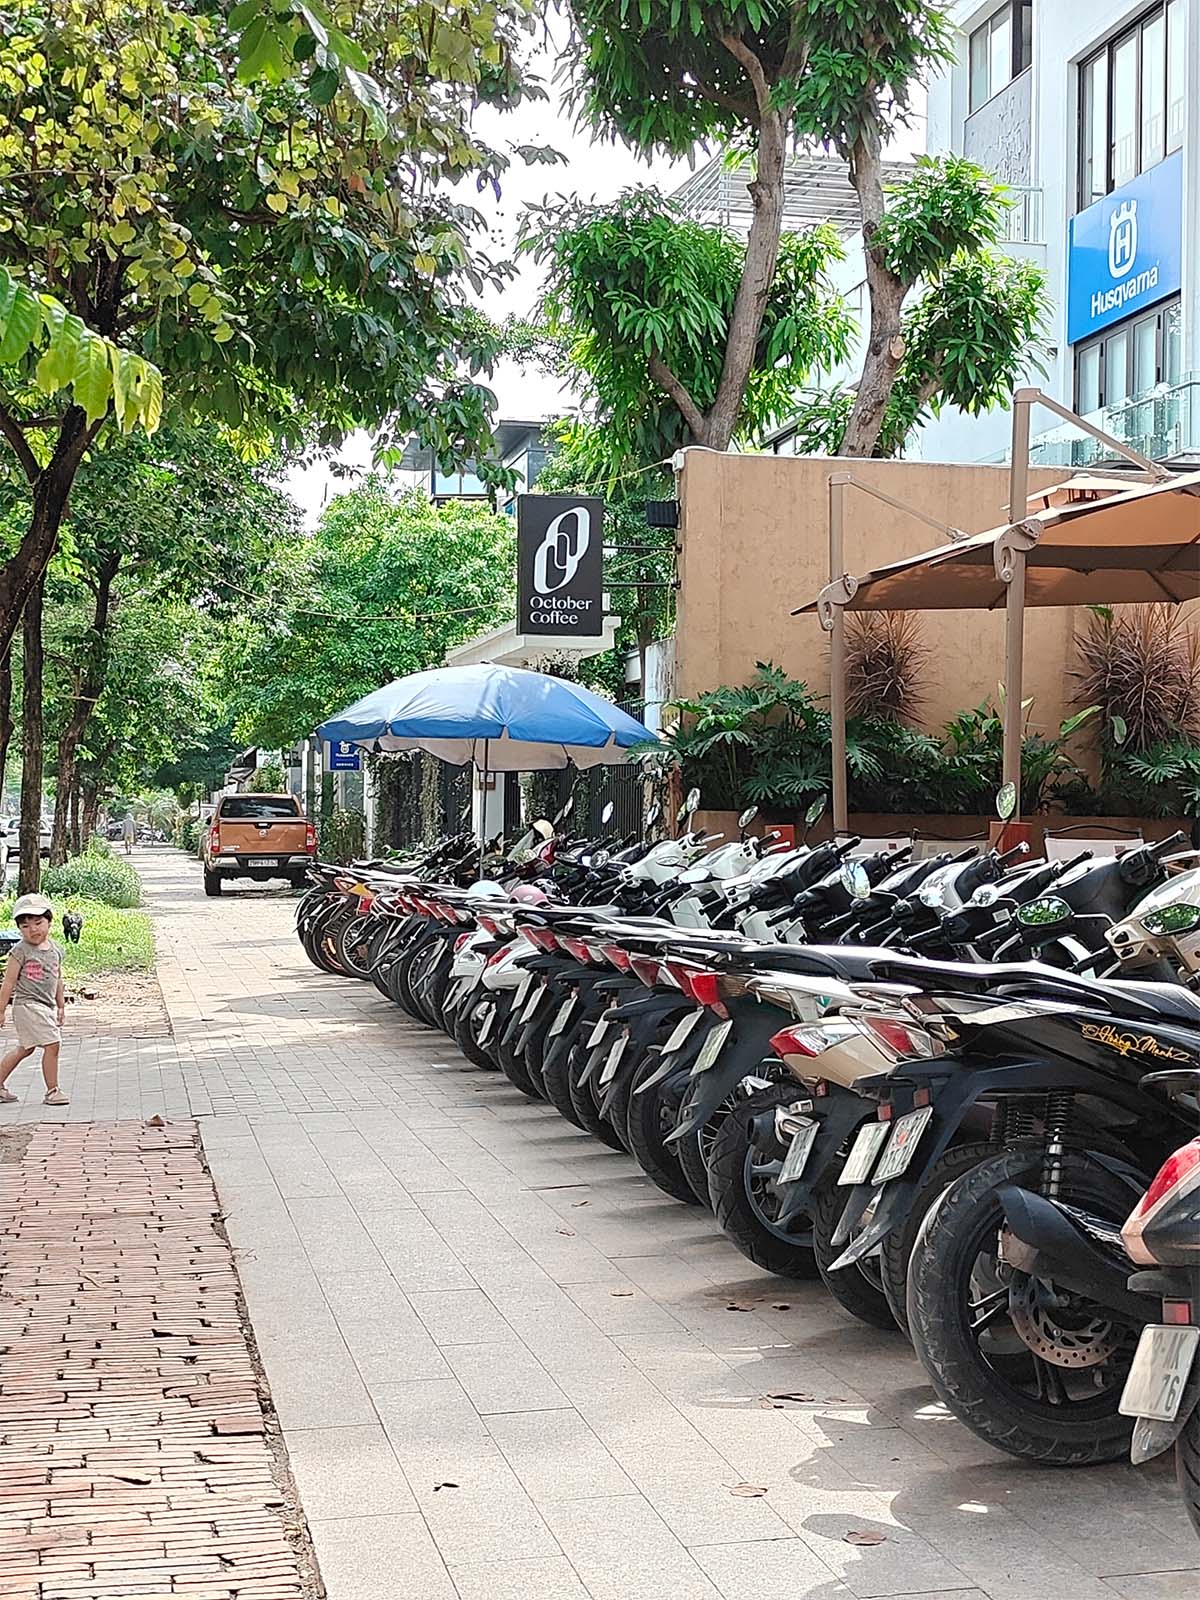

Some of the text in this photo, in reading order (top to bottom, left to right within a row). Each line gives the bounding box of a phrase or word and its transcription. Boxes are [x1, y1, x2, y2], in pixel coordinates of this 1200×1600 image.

[1091, 266, 1159, 318] Husqvarna
[529, 596, 593, 610] October
[529, 610, 579, 625] Coffee
